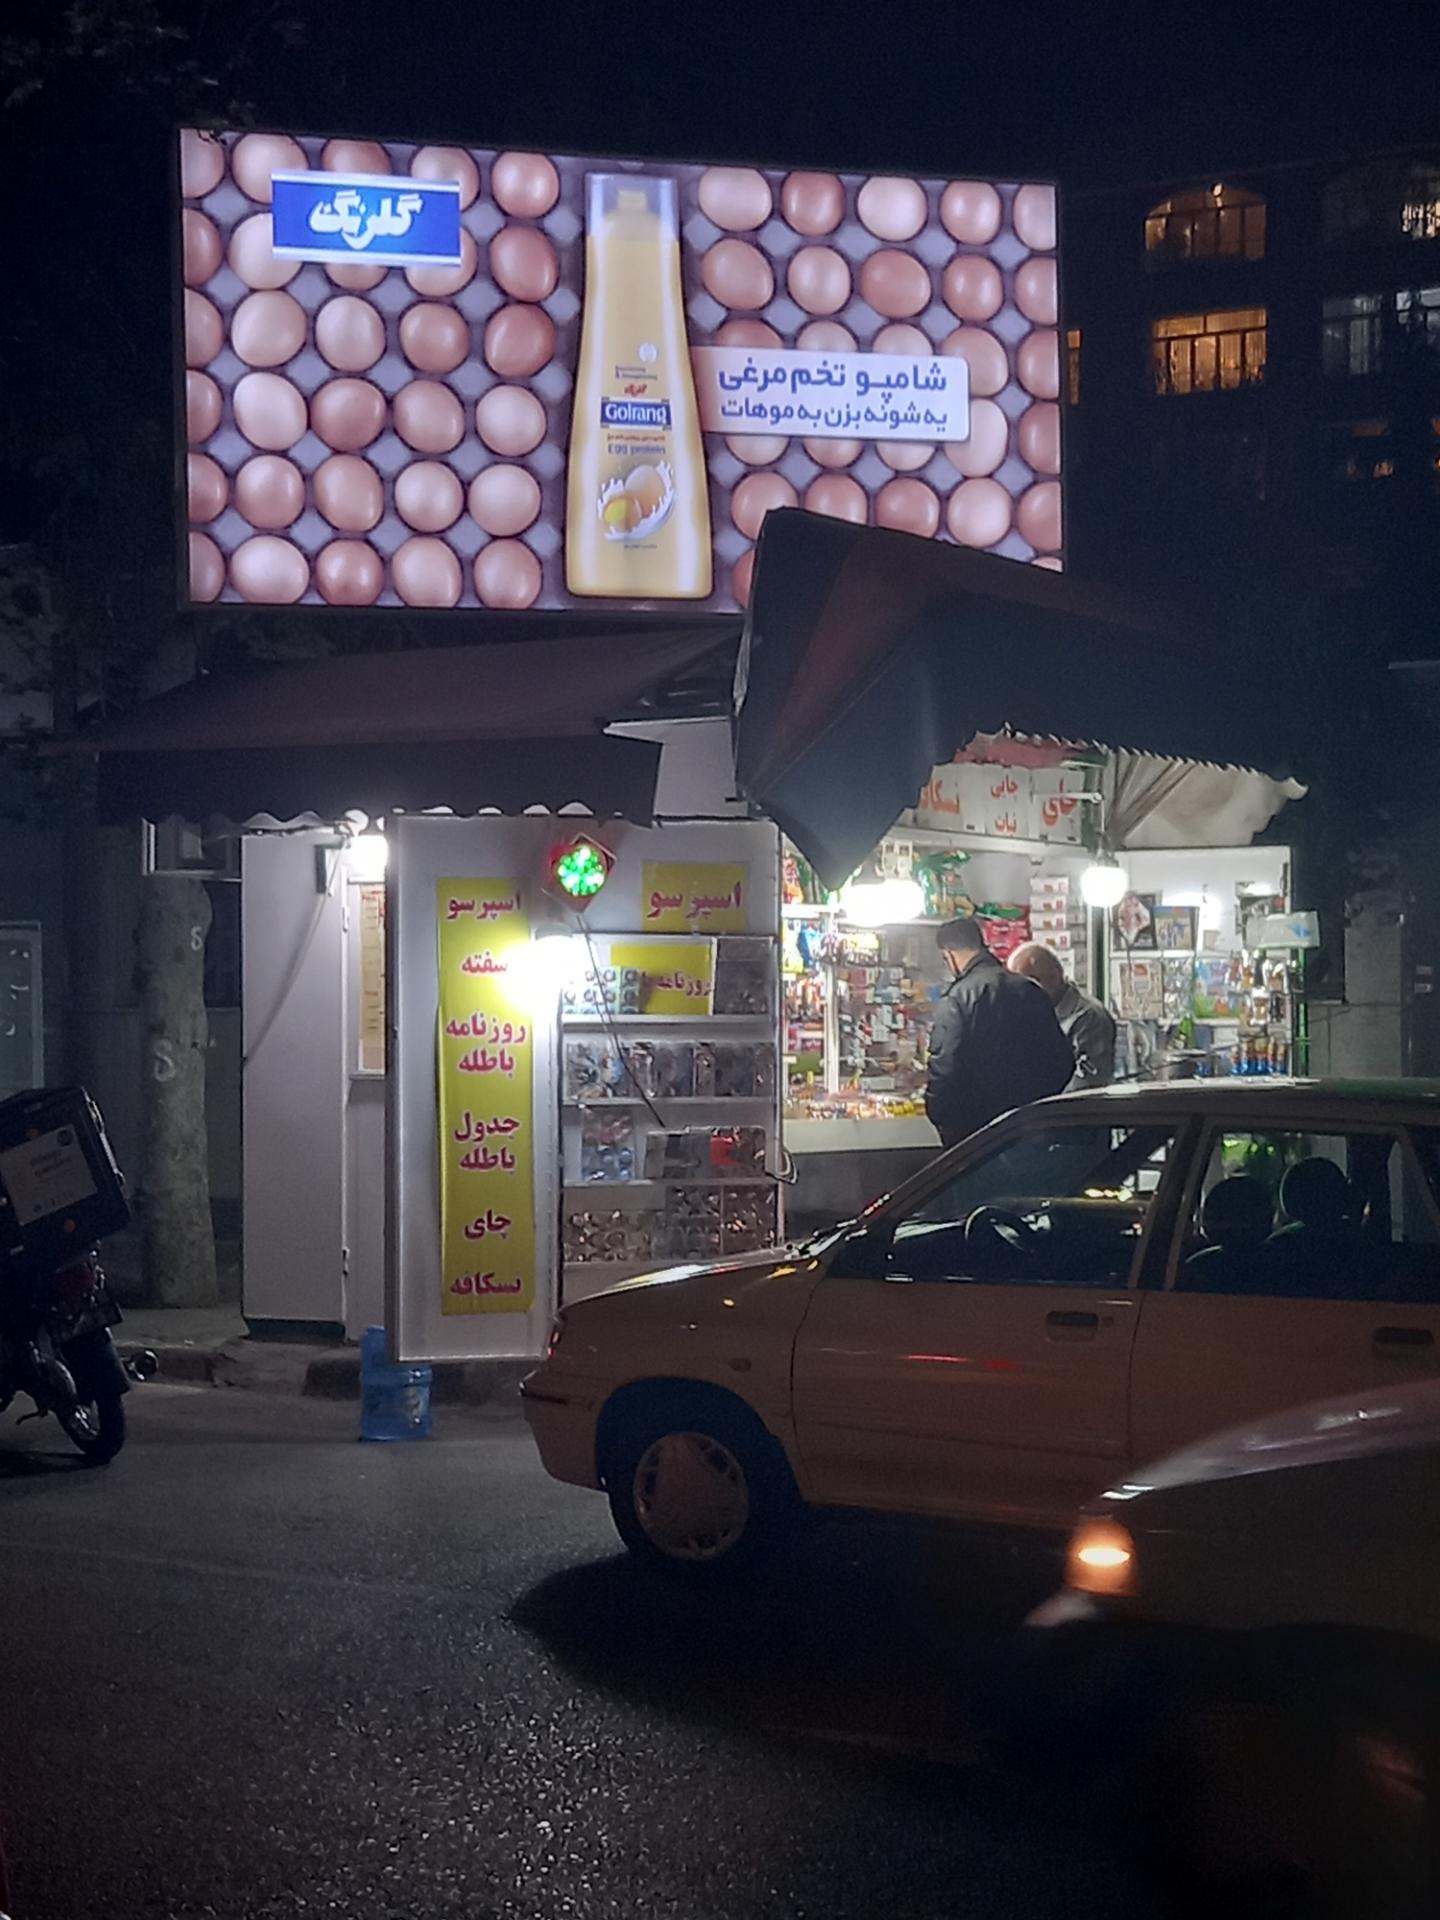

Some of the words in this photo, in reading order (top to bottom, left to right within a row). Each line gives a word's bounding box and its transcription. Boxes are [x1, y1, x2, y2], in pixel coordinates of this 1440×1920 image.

[309, 189, 423, 250] گلرنگ
[719, 357, 787, 392] مرغی
[791, 359, 846, 393] تخم
[855, 362, 947, 404] شامپو
[605, 402, 667, 424] Golrang
[720, 397, 794, 425] موهات
[796, 408, 822, 428] به
[824, 403, 862, 430] بزن
[864, 401, 921, 429] شونه
[924, 411, 948, 432] یه
[446, 890, 522, 920] اسپرسو
[646, 880, 742, 920] اسپرسو
[446, 1010, 526, 1043] روزنامه
[458, 1047, 516, 1078] باطله
[454, 1111, 520, 1142] جدول
[459, 1145, 516, 1175] باطله
[464, 1208, 512, 1240] چای
[449, 1270, 522, 1296] نسکافه
